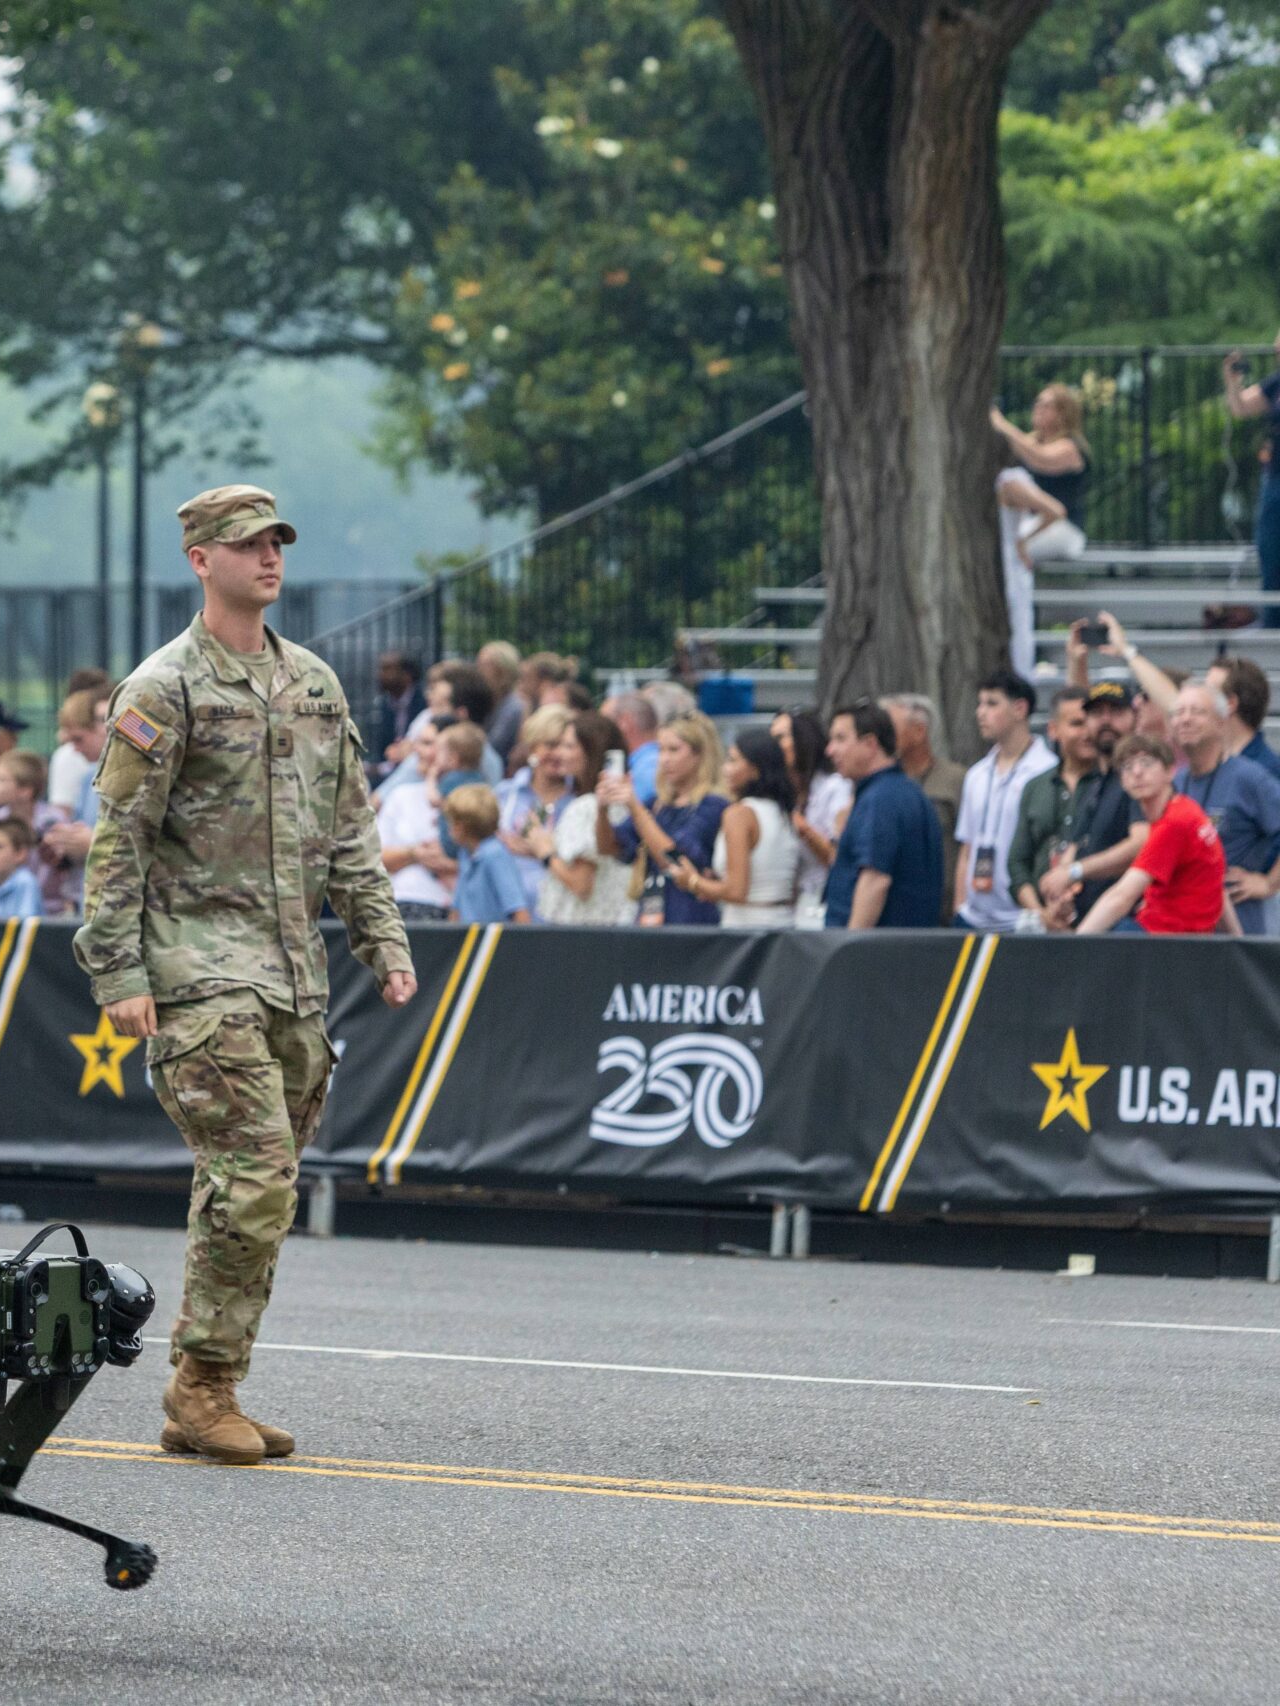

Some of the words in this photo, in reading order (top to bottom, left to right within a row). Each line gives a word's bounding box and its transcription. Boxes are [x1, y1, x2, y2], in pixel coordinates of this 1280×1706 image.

[602, 982, 765, 1026] AMERICA
[588, 1032, 764, 1149] 250
[1117, 1064, 1200, 1125] U.S.
[1205, 1067, 1280, 1128] AR
